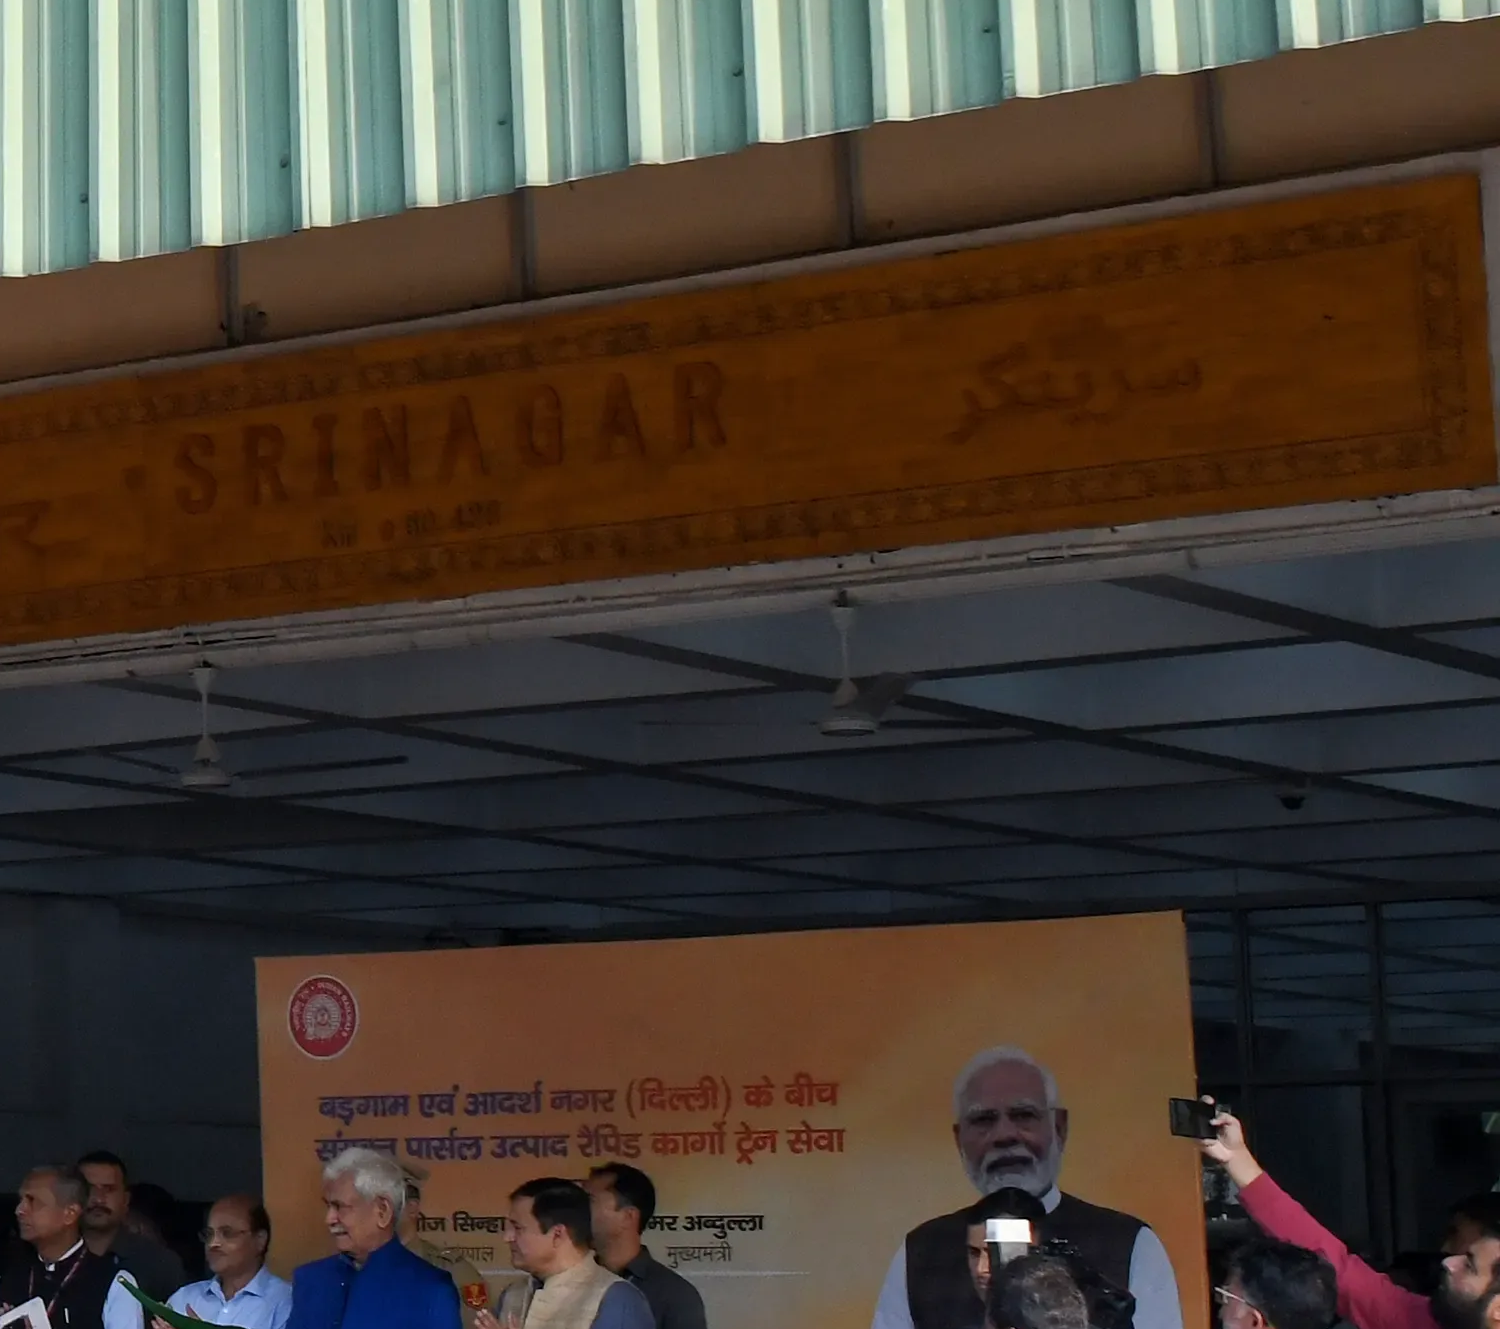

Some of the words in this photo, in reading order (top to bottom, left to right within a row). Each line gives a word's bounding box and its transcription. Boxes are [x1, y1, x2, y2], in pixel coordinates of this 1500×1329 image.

[172, 359, 728, 517] SRINAGAR
[317, 1095, 411, 1125] बड़गाम
[418, 1084, 459, 1117] एवं
[464, 1081, 543, 1116] आदर्श
[549, 1088, 617, 1113] नगर
[626, 1075, 731, 1118] (दिल्ली)
[742, 1075, 775, 1108] के
[784, 1072, 840, 1108] बीच
[405, 1128, 484, 1160] पार्सल
[490, 1135, 570, 1158] उत्पाद
[577, 1123, 643, 1159] रैपिड
[650, 1121, 727, 1156] कार्गो
[734, 1121, 778, 1164] ट्रेन
[786, 1120, 847, 1154] सेवा
[452, 1211, 506, 1233] सिन्हा
[683, 1215, 764, 1240] अब्दुल्ला
[667, 1244, 733, 1268] मुख्यमंत्री
